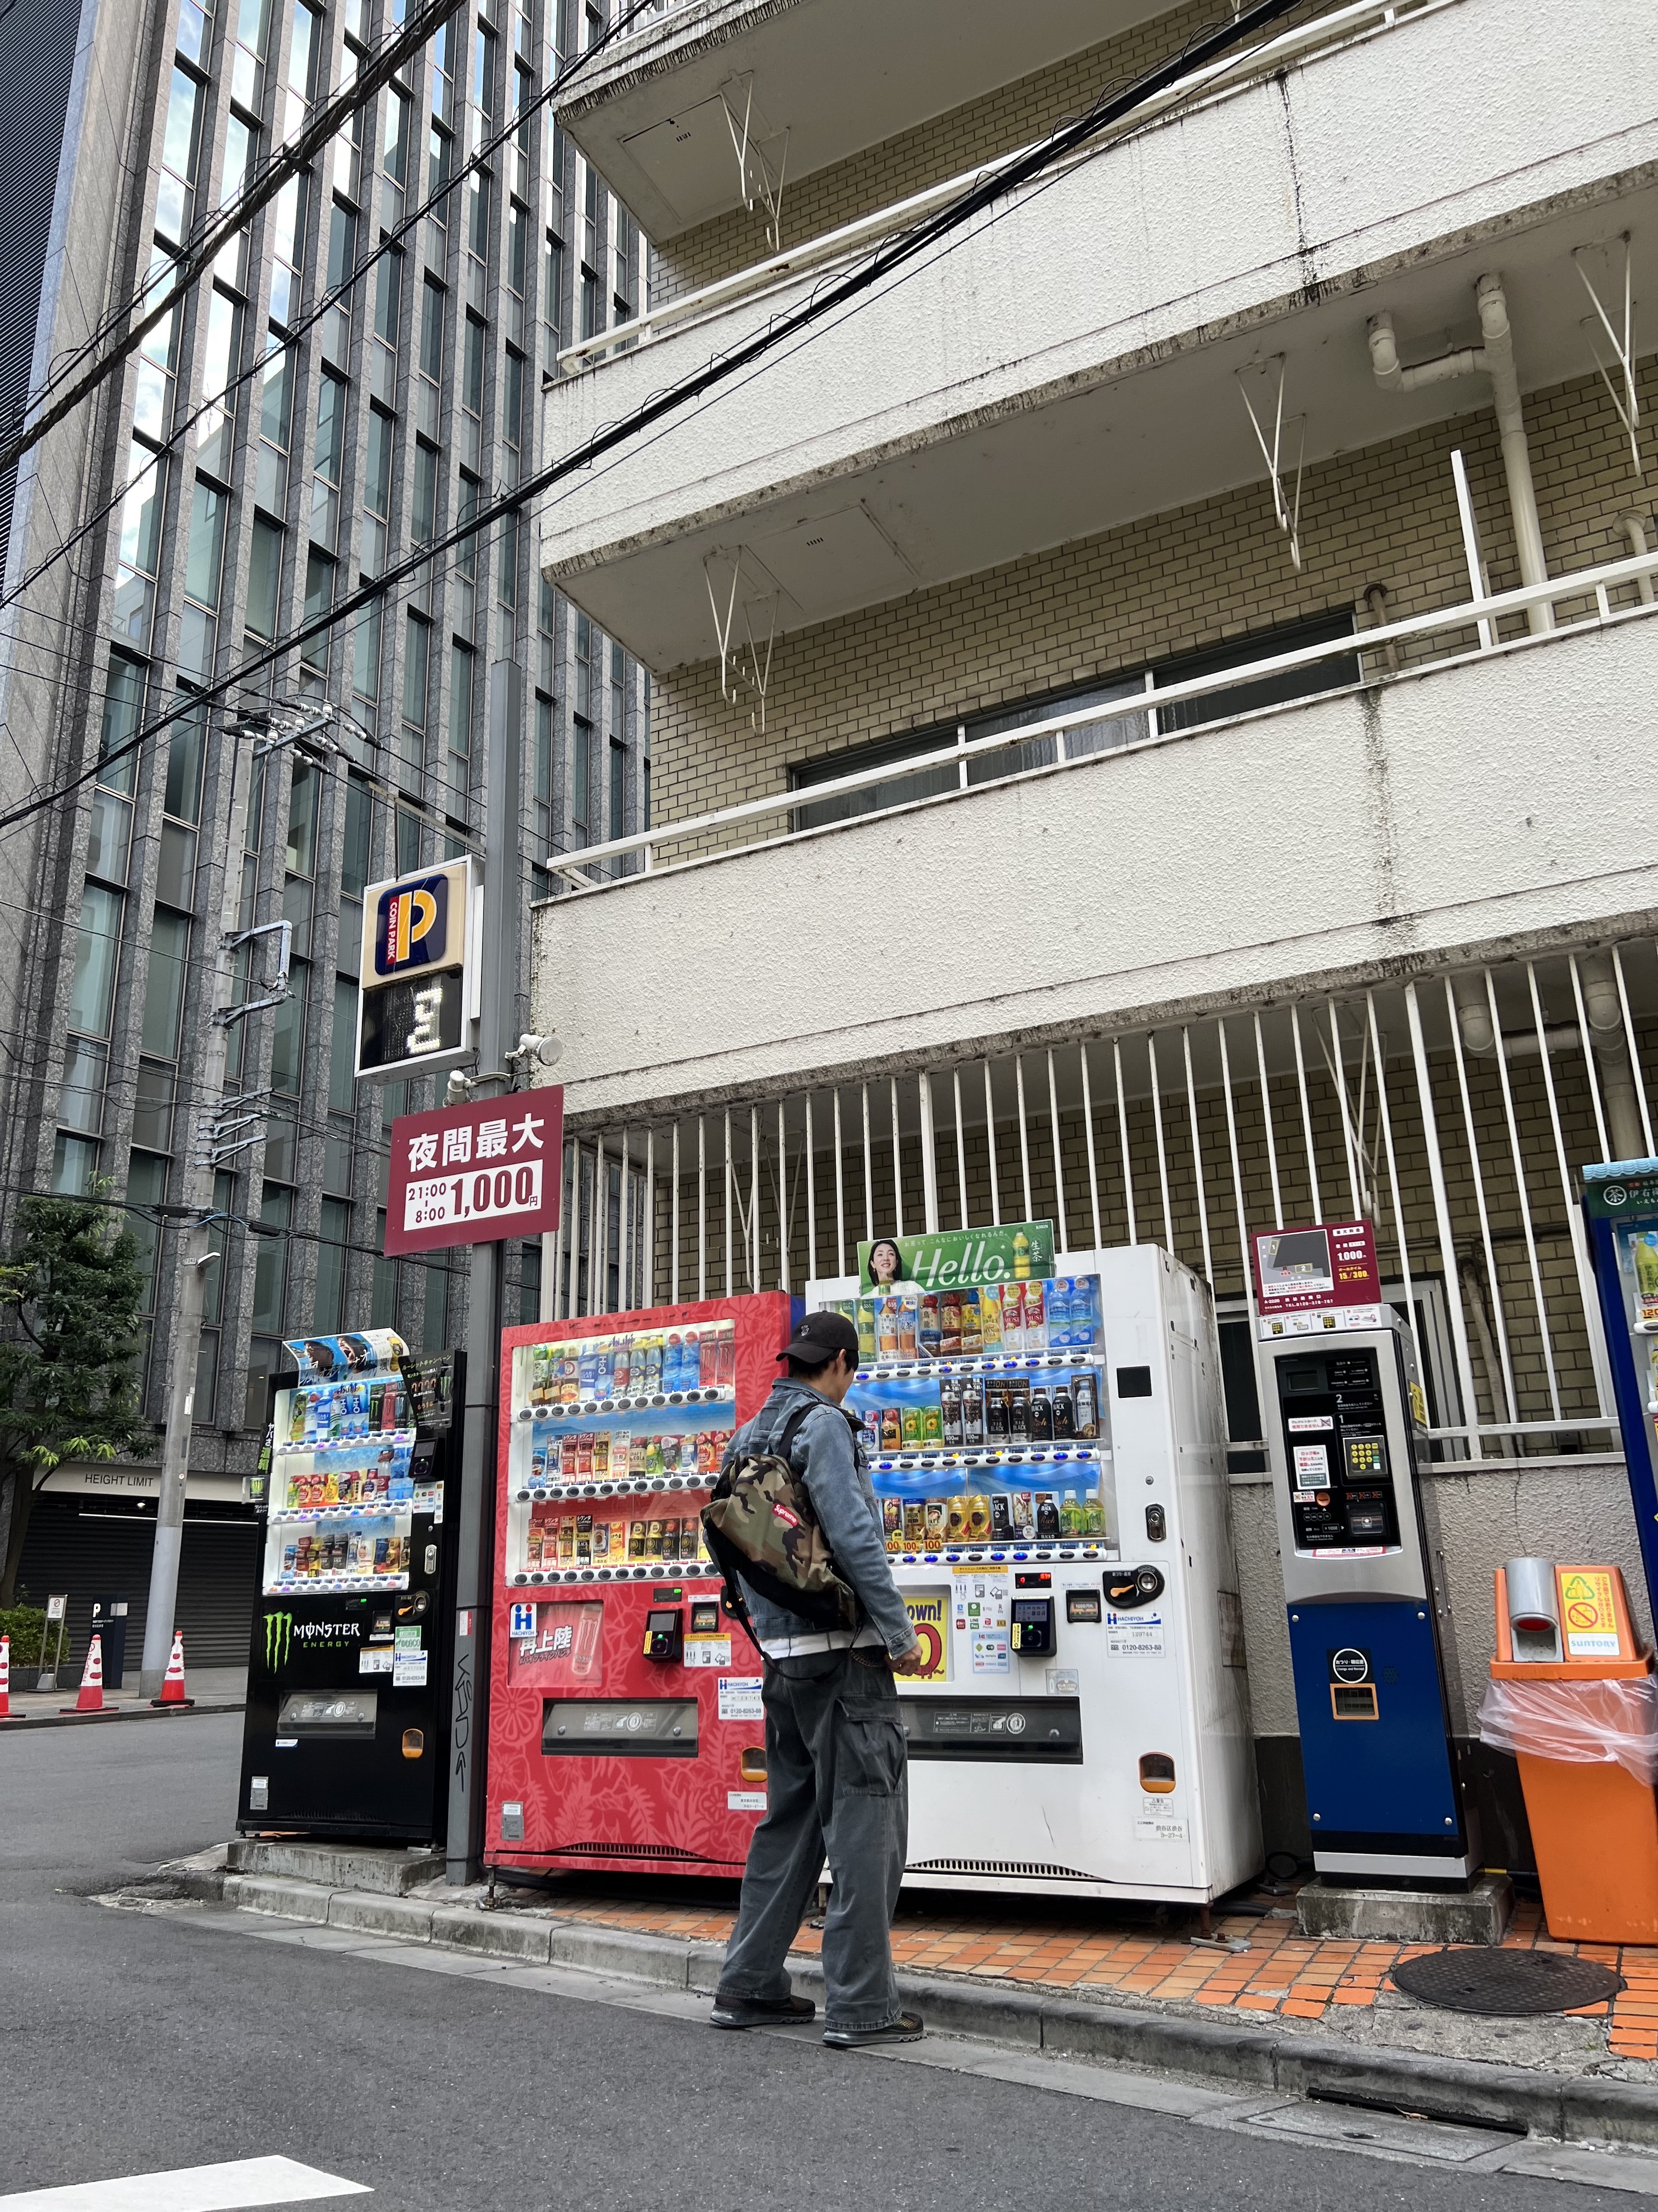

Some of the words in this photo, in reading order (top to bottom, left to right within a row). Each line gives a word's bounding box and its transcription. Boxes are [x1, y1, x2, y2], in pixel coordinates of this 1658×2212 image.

[388, 901, 398, 929] COIN
[397, 889, 437, 962] P
[387, 931, 397, 960] PARK
[408, 1113, 544, 1172] 夜間最大
[408, 1182, 446, 1201] 21:00
[451, 1166, 537, 1218] 1,000円
[415, 1206, 445, 1223] 8:00
[1031, 1240, 1042, 1262] 生茶
[910, 1240, 1010, 1287] Hello.
[598, 1356, 607, 1374] H2O
[1336, 1394, 1343, 1403] 2
[1339, 1414, 1344, 1424] 1
[85, 1474, 126, 1485] HEIGHT
[127, 1476, 154, 1487] LIMIT
[774, 1504, 797, 1523] Supreme
[93, 1603, 101, 1618] P
[907, 1600, 942, 1621] own!
[293, 1621, 360, 1639] MONSTER
[520, 1625, 573, 1657] 再上陸
